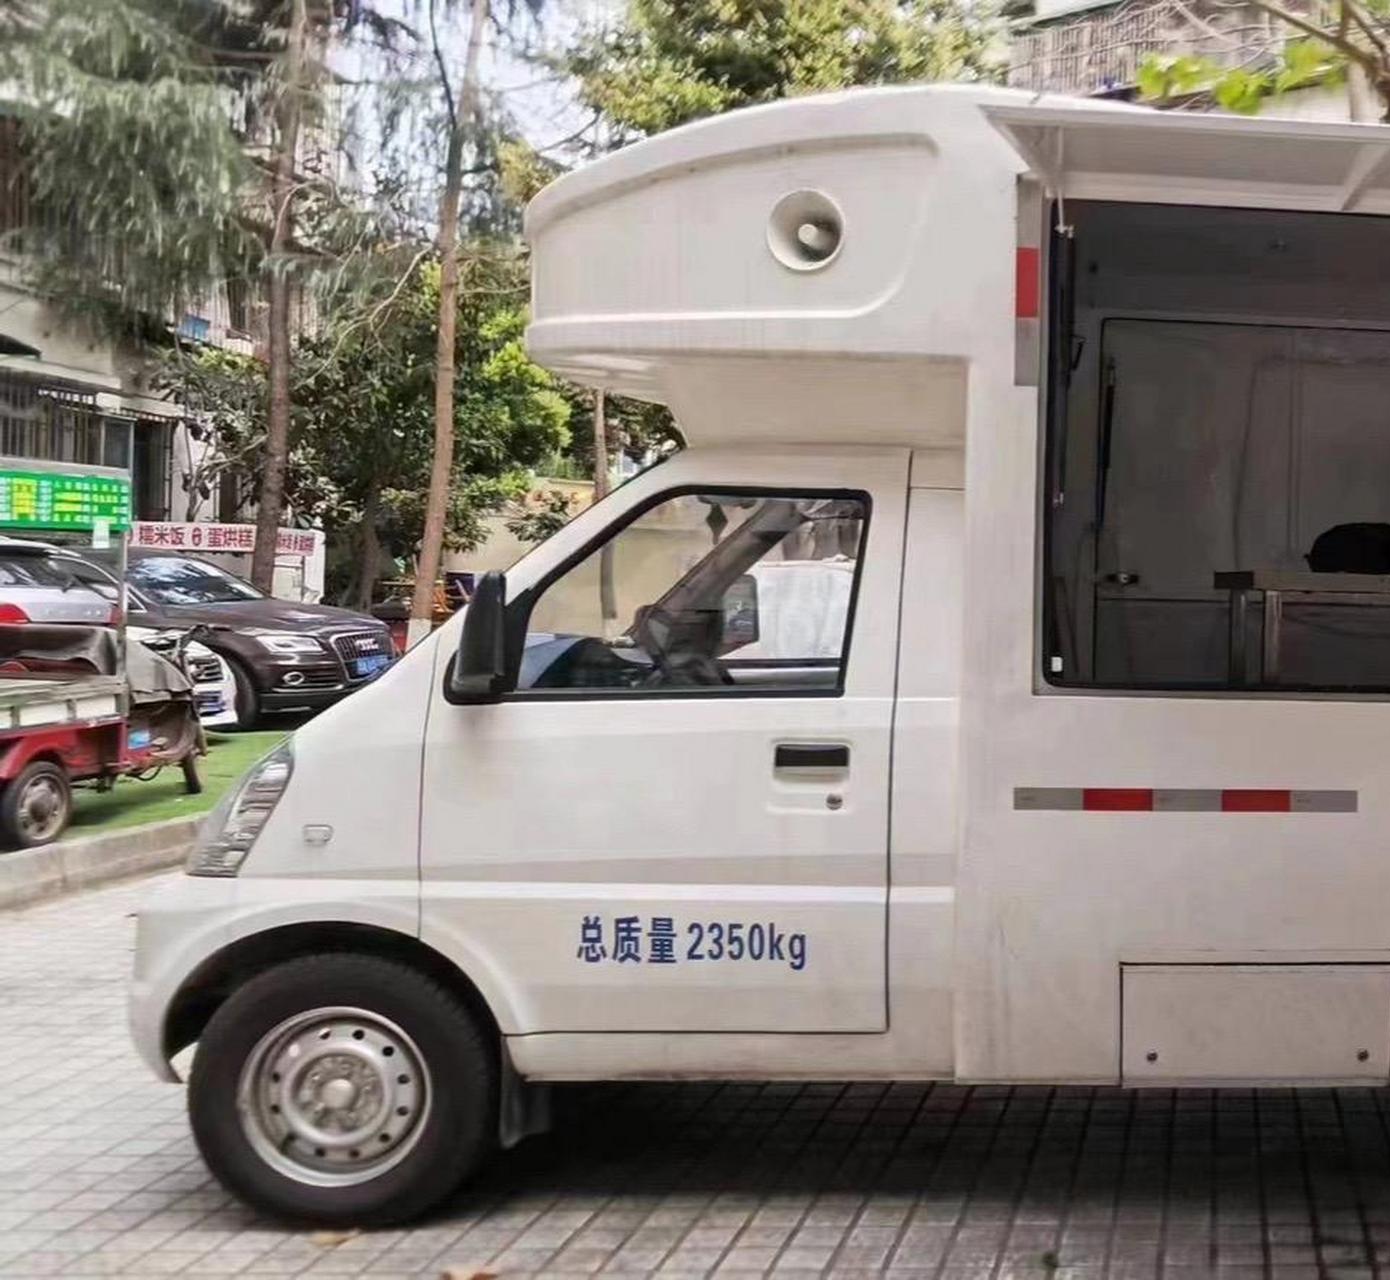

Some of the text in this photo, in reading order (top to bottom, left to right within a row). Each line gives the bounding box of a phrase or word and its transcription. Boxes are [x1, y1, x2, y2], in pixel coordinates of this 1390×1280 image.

[577, 915, 806, 970] 总质量 2350kg
